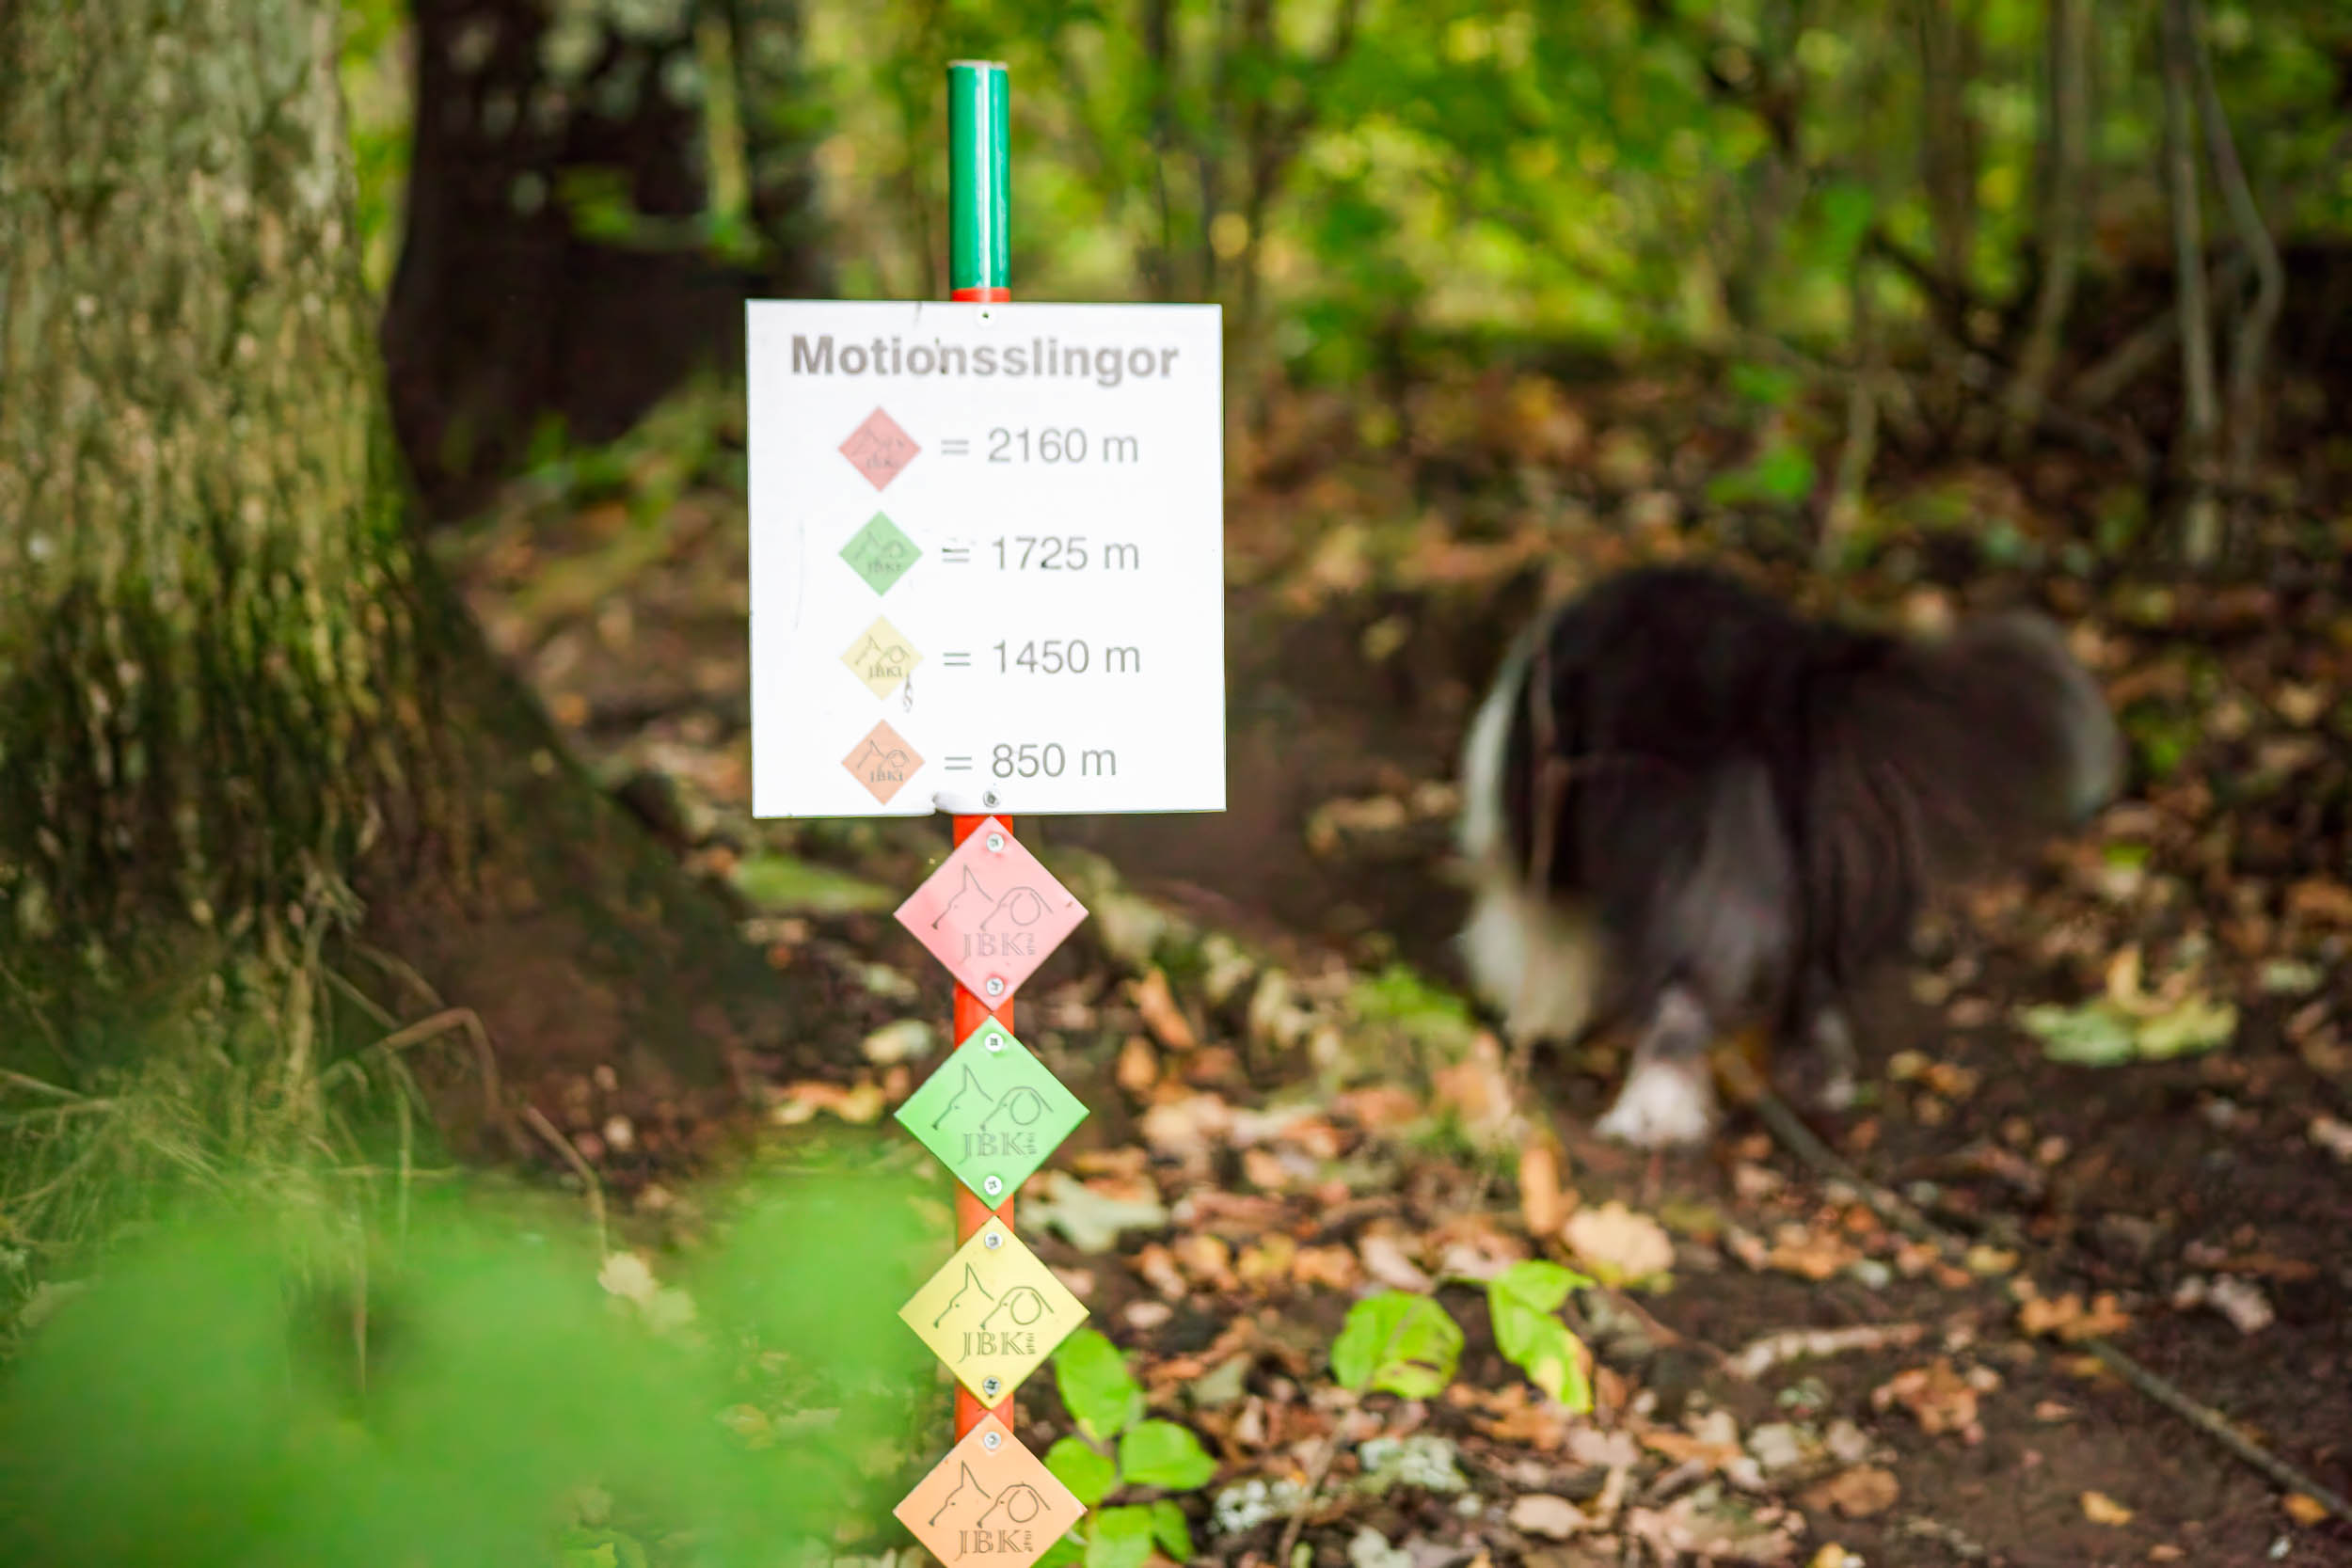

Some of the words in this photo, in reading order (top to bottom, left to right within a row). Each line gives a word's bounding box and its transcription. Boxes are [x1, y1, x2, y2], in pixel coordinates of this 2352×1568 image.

[791, 334, 1180, 388] Motionsslingor
[988, 428, 1087, 463] 2160
[1104, 436, 1138, 463] m
[993, 536, 1088, 571] 1725
[1104, 543, 1139, 570] m
[993, 640, 1089, 674] 1450
[1105, 646, 1141, 673] m
[992, 743, 1065, 778] 850
[1082, 750, 1117, 776] m
[959, 933, 1024, 964] JBK
[959, 1132, 1025, 1164] JBK
[958, 1332, 1025, 1363] JBK
[954, 1530, 1023, 1561] JBK
